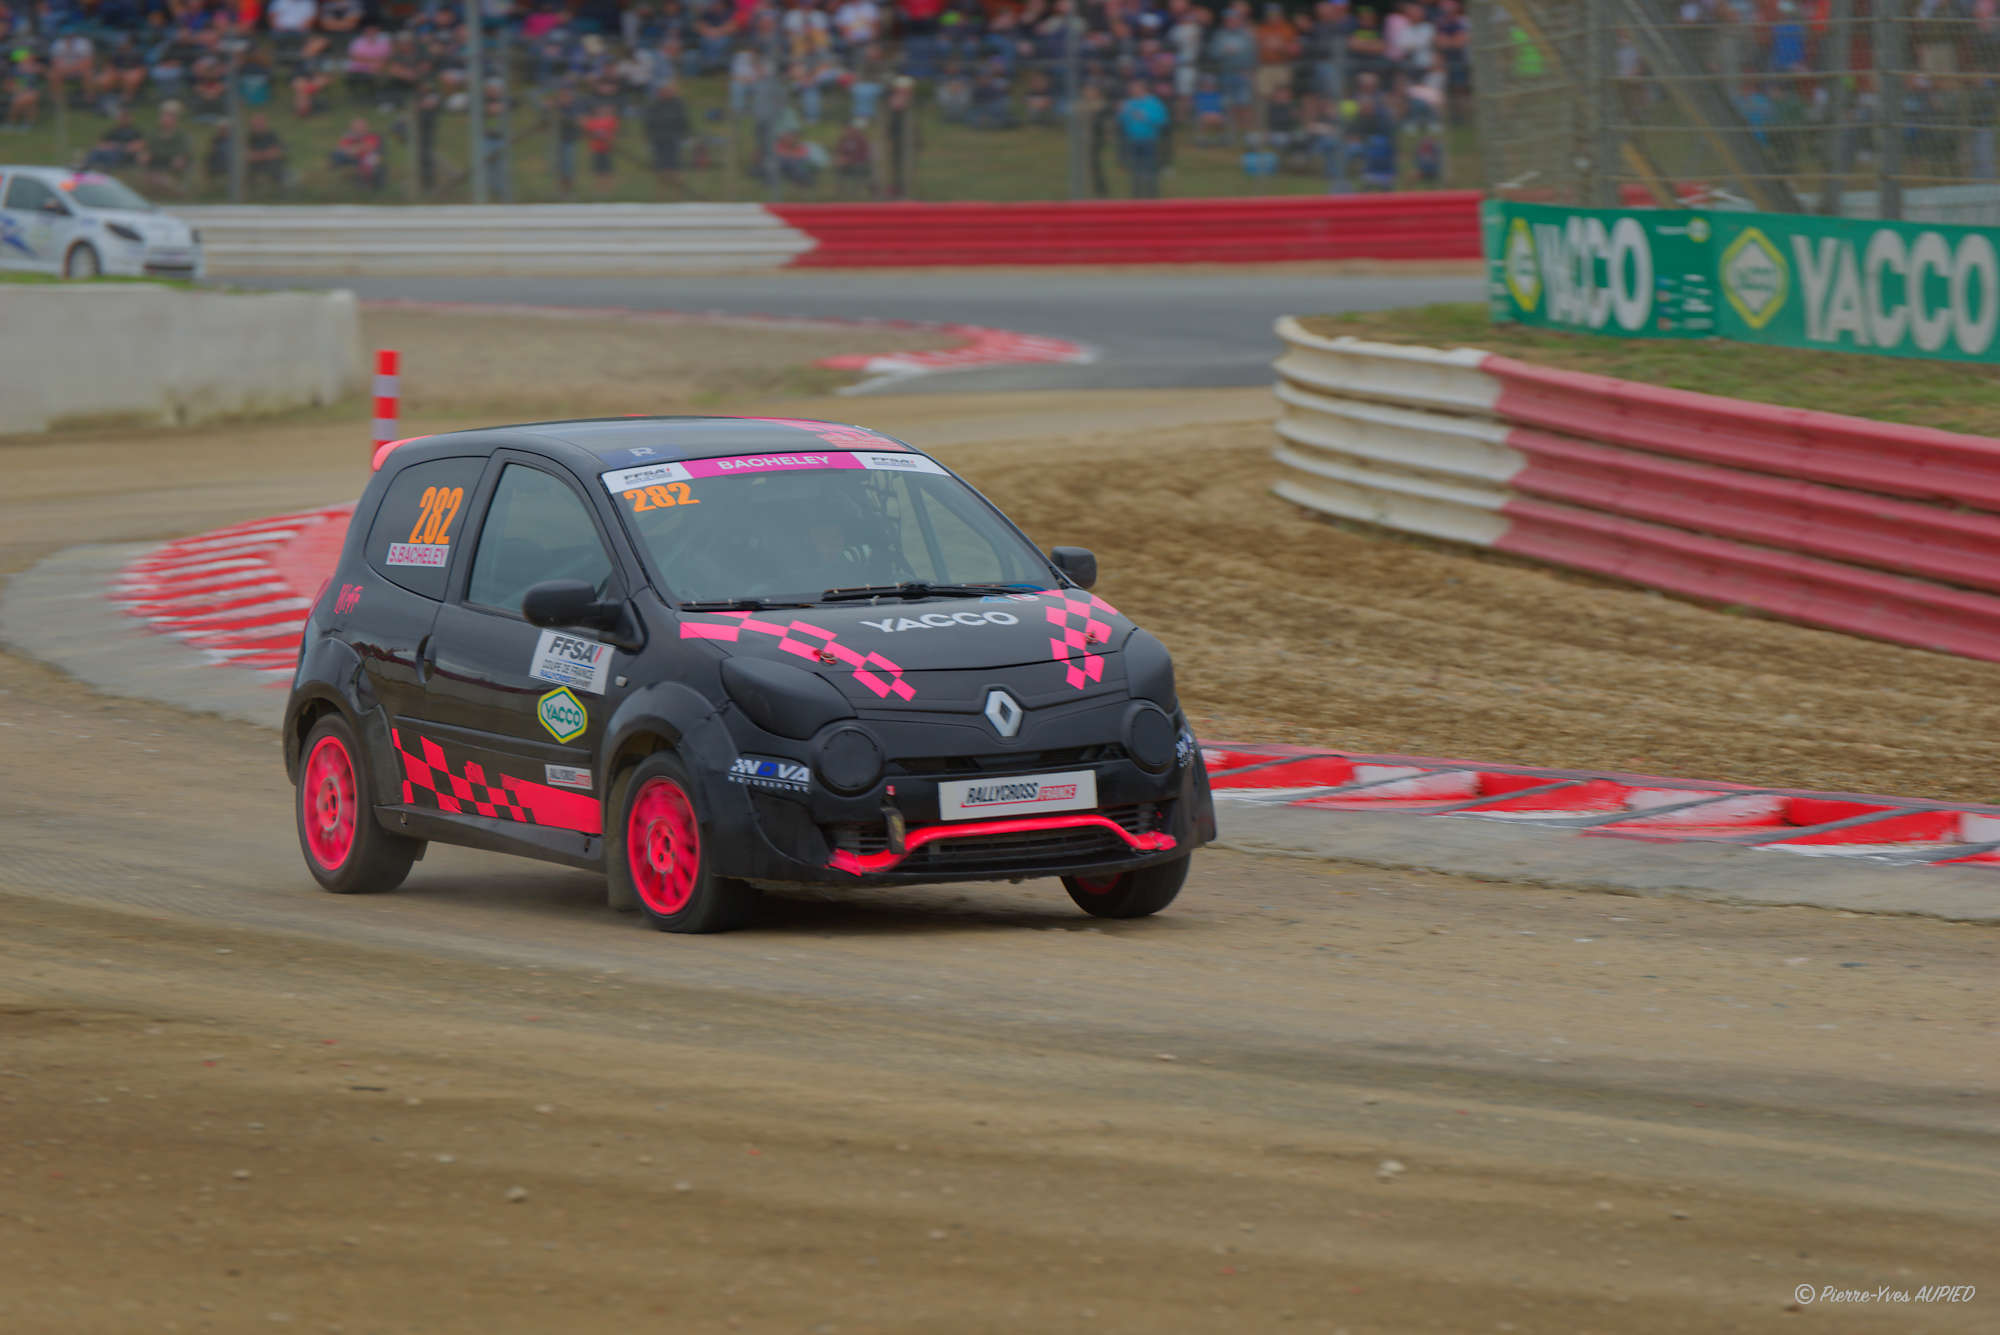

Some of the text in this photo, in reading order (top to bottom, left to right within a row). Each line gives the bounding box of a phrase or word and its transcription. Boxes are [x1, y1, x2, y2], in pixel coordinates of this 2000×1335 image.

[1789, 228, 1998, 354] YACCO
[718, 456, 829, 470] BACHELEY
[623, 482, 701, 513] 282
[408, 486, 464, 545] 282
[859, 611, 1020, 633] YACCO
[548, 636, 594, 662] FFSA
[545, 703, 581, 727] YACCO
[966, 782, 1039, 804] RALLYCROSS
